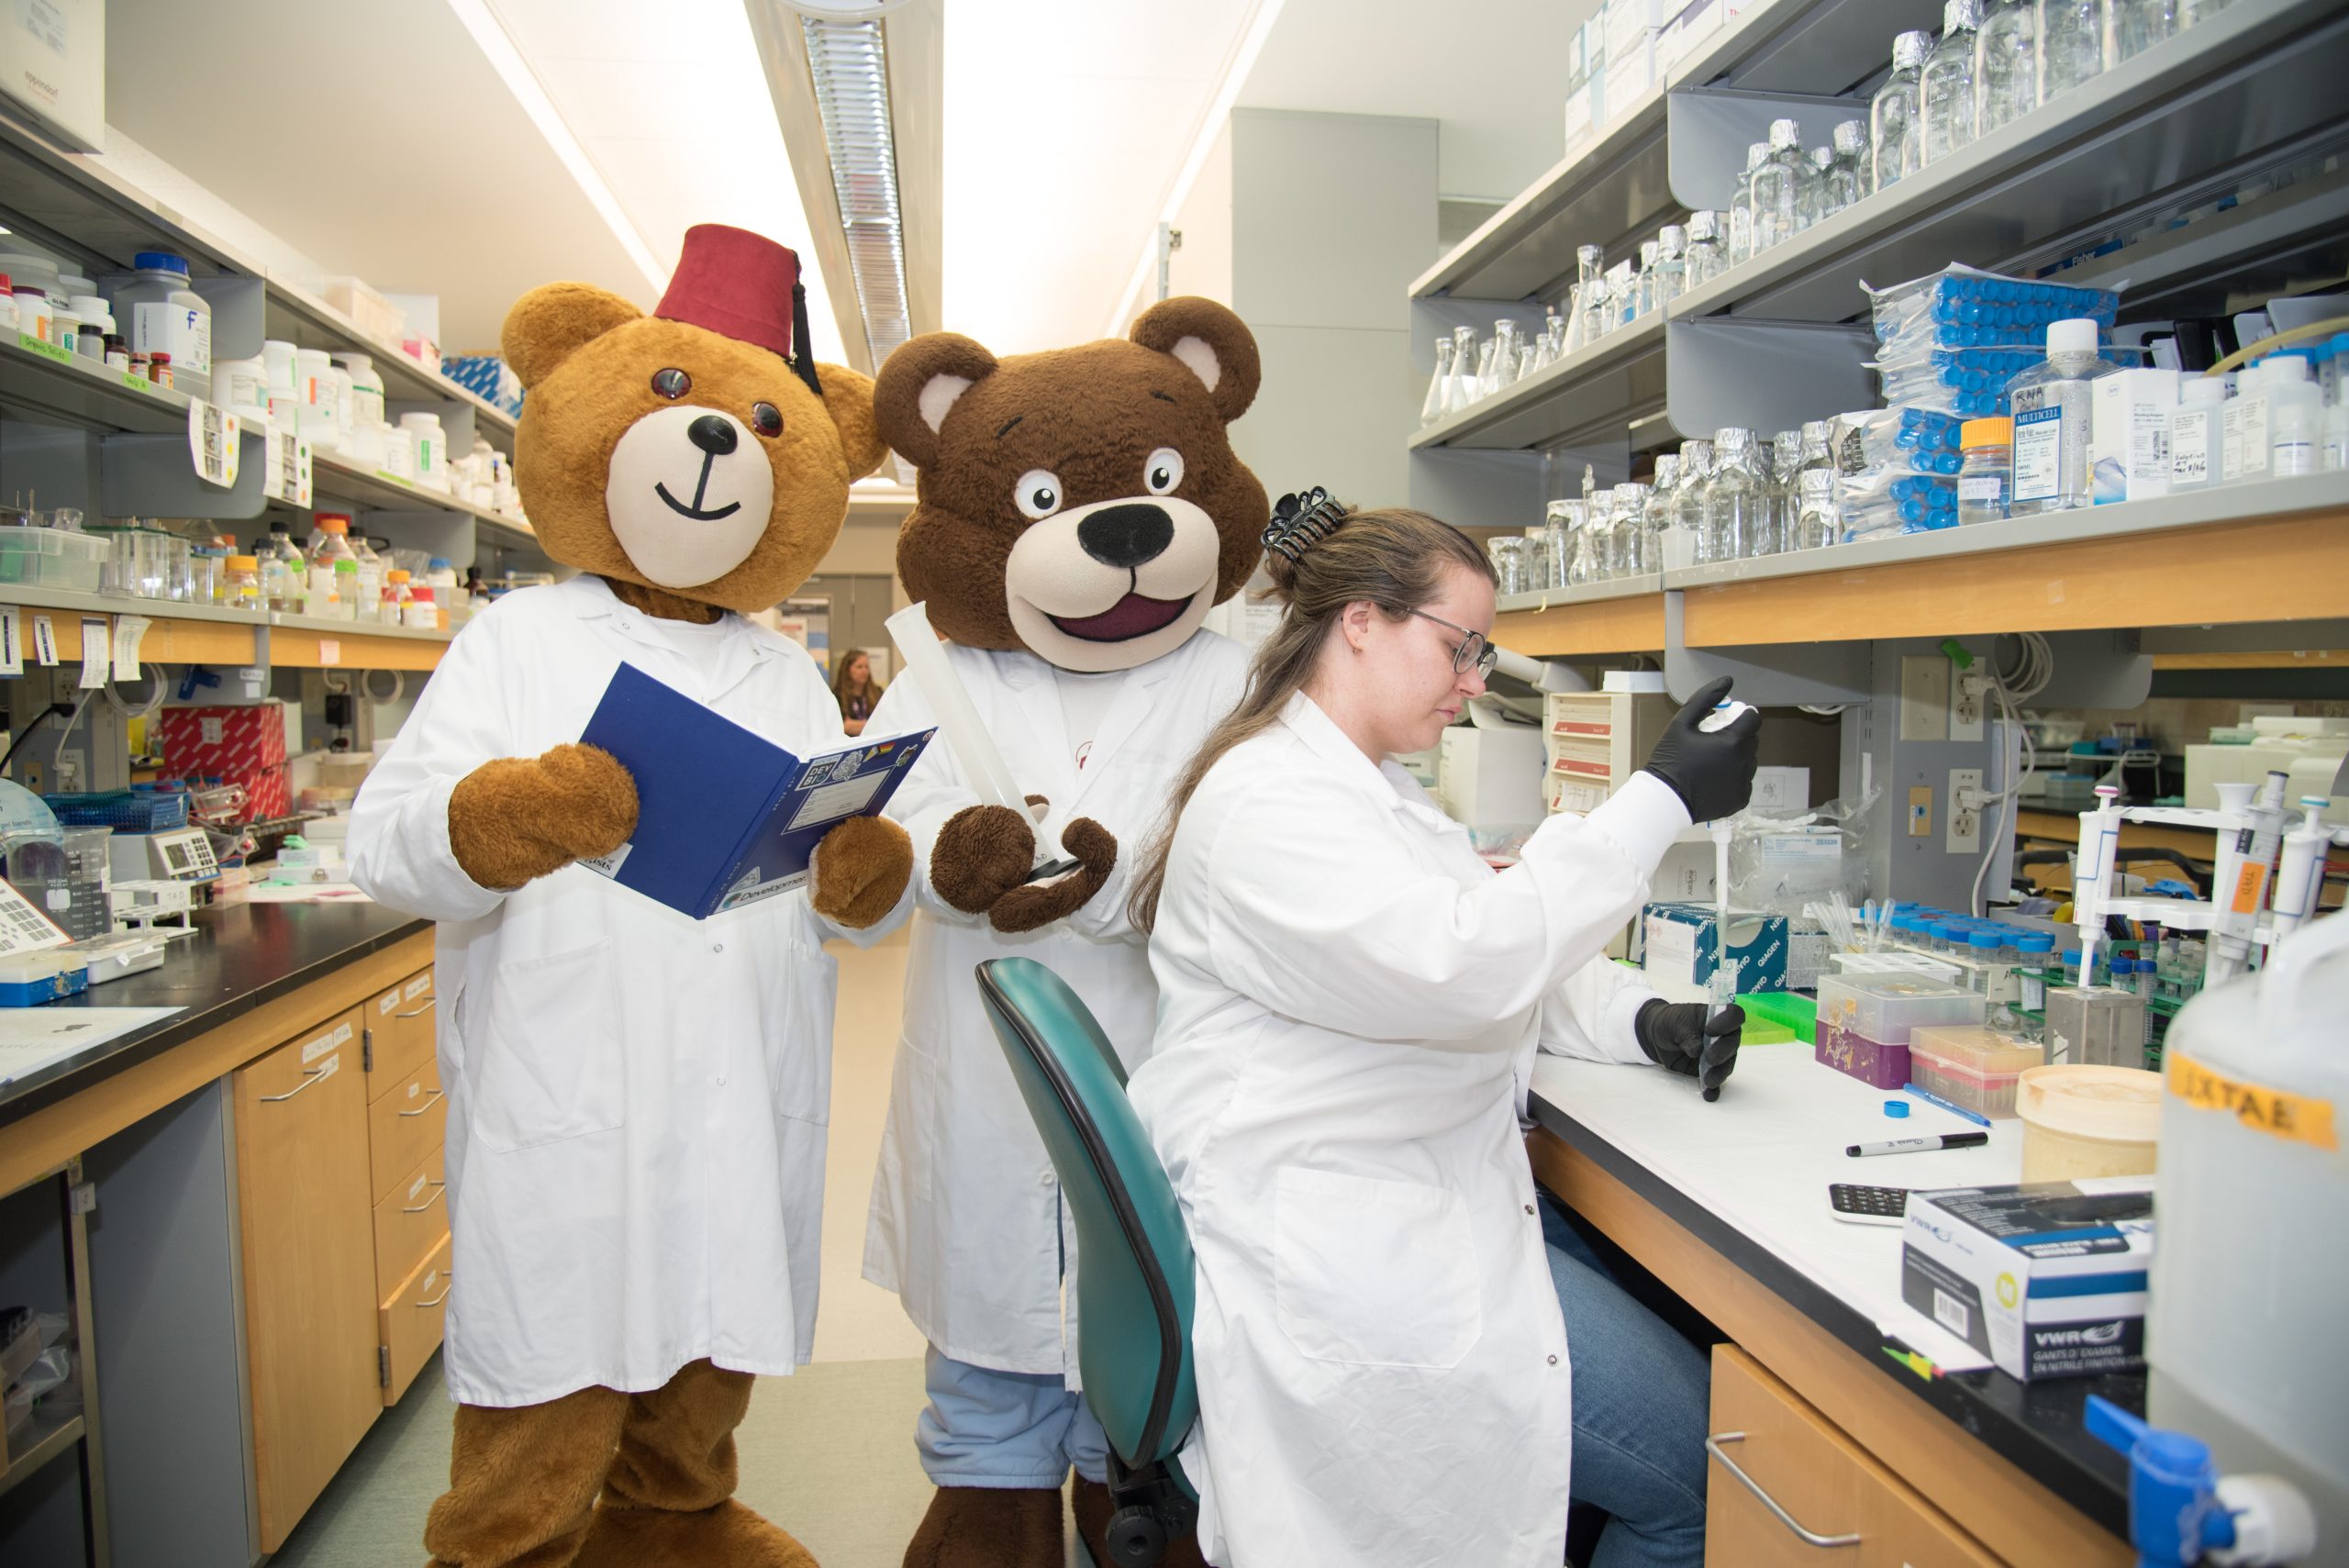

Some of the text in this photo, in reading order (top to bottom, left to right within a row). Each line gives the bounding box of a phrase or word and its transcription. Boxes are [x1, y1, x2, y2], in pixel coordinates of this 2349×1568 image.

[25, 70, 59, 96] eppendorf
[2072, 250, 2097, 267] Fisher
[186, 310, 197, 330] F
[2016, 386, 2043, 404] RNA
[2017, 407, 2058, 425] MULTICELL
[809, 763, 833, 776] DEV
[1757, 940, 1781, 967] QIAGEN
[2034, 1330, 2081, 1347] VWR
[2033, 1349, 2066, 1361] GANTS
[2080, 1345, 2122, 1357] EXAMEN
[2032, 1362, 2047, 1373] EN
[2047, 1359, 2083, 1372] NITRILE
[2085, 1356, 2124, 1368] FINITION
